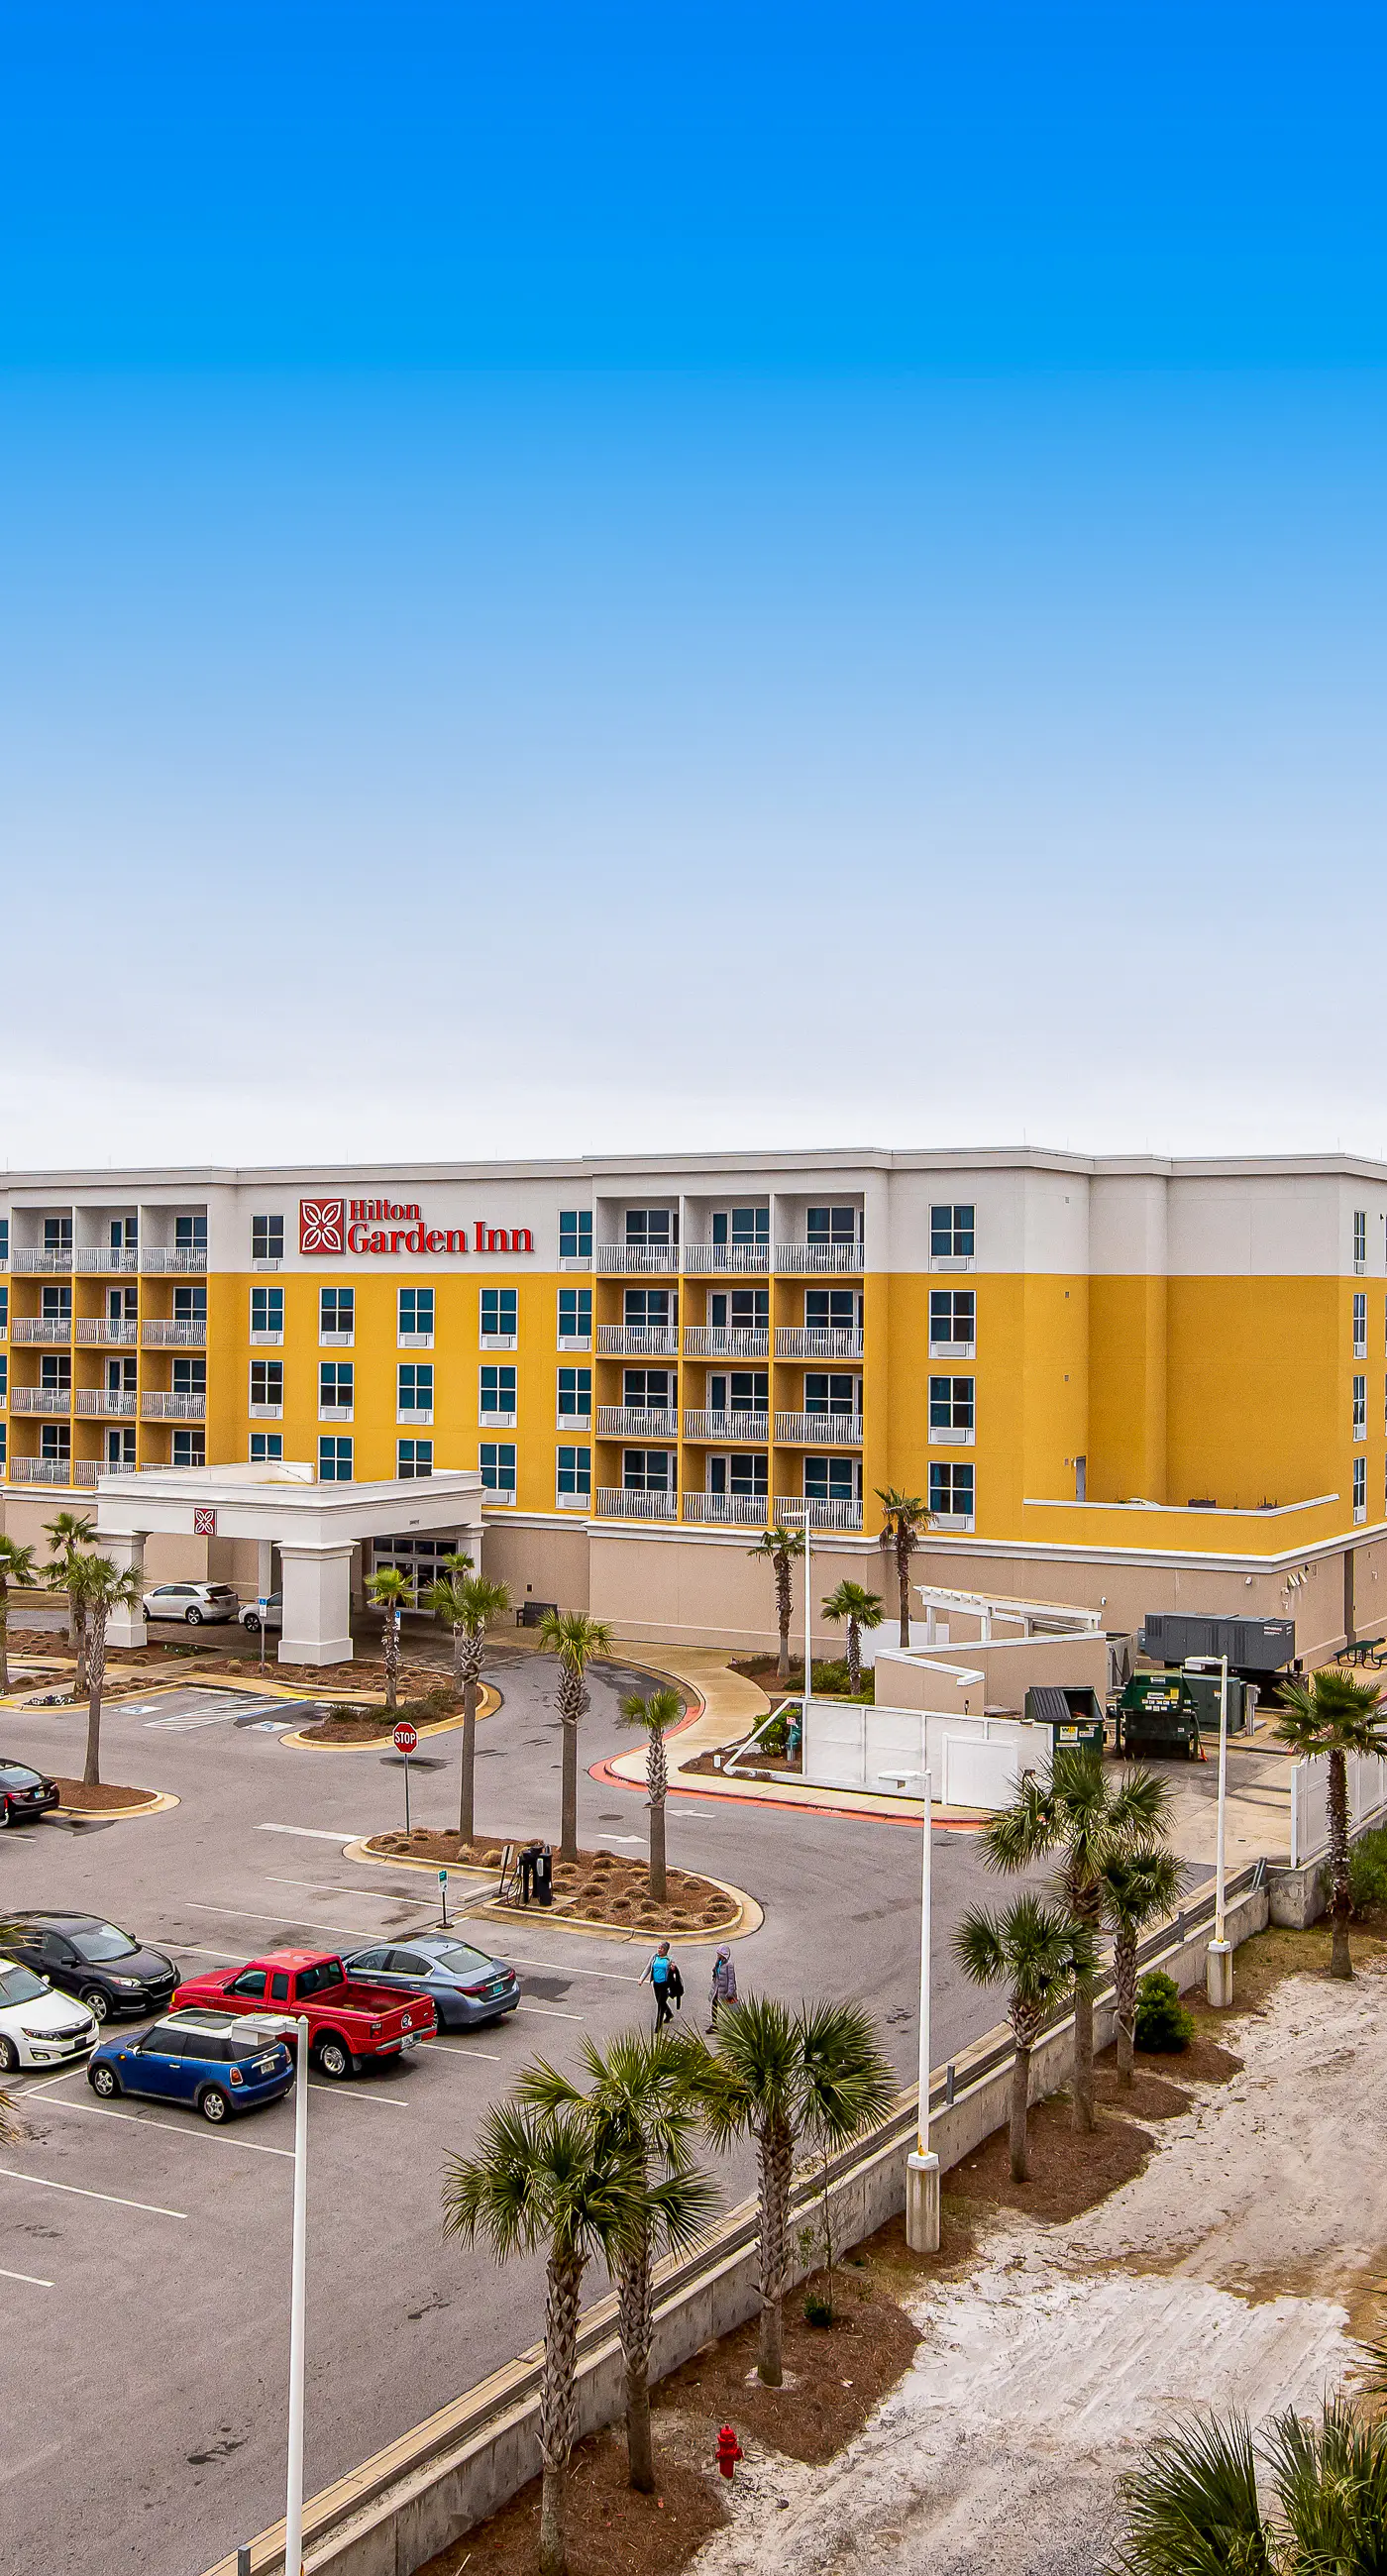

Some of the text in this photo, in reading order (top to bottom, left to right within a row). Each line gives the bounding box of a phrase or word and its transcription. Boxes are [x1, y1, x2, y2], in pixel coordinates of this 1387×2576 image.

[348, 1199, 422, 1221] Hilton
[347, 1221, 535, 1254] Garden Inn
[395, 1732, 416, 1744] STOP
